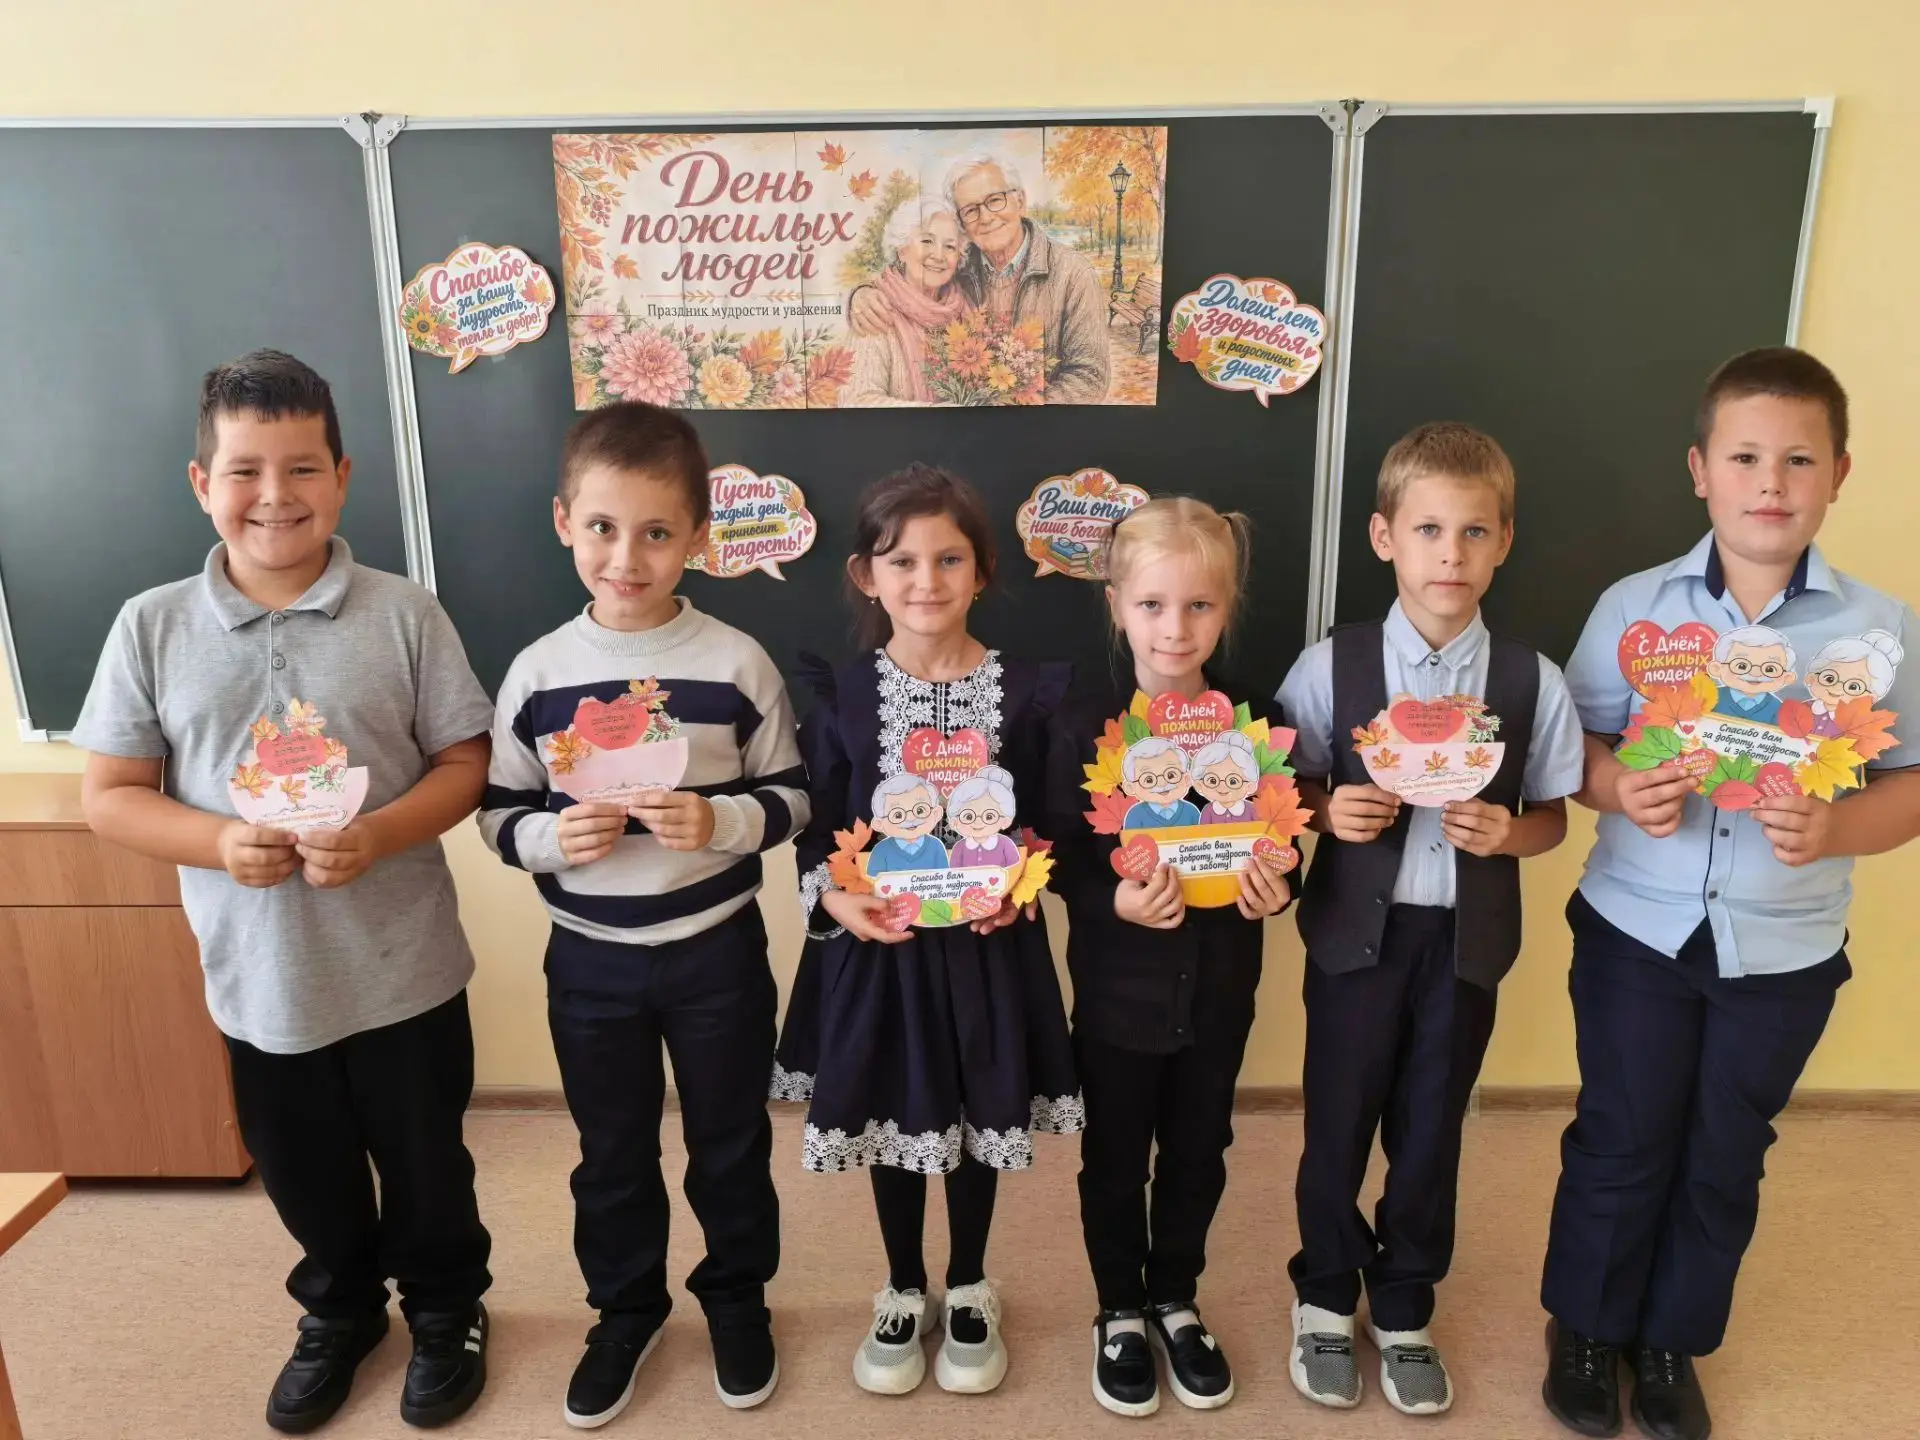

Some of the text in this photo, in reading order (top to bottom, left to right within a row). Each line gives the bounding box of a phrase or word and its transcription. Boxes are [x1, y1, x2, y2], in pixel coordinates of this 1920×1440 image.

[660, 150, 815, 209] День
[620, 211, 857, 247] пожилых
[430, 251, 527, 305] Спасибо
[660, 244, 820, 298] людей
[456, 283, 516, 316] за вашу
[1198, 279, 1321, 338] Долгих лет,
[456, 299, 528, 332] мудрость,
[648, 303, 842, 321] Праздник мудрости и уважения
[457, 306, 542, 349] тепло и добро!
[1217, 340, 1297, 369] и радостных
[1220, 359, 1280, 385] дней!
[1038, 487, 1088, 519] Ваш
[711, 502, 788, 526] ждый день
[721, 522, 780, 543] приносит
[1029, 520, 1069, 535] наше
[722, 529, 802, 567] радость!
[1638, 635, 1701, 656] С Днём
[1631, 652, 1710, 673] пожилых
[1643, 666, 1699, 684] людей!
[1165, 702, 1217, 720] С Днём
[1159, 719, 1224, 735] пожилых
[1719, 723, 1784, 744] Спасибо вам
[921, 740, 973, 757] С Днём
[1172, 731, 1216, 747] людей!
[1702, 731, 1802, 760] за доброту, мудрость
[915, 756, 980, 772] пожилых
[926, 768, 972, 784] людей!
[1168, 850, 1252, 865] за доброту, мудрость
[1178, 840, 1232, 854] Спасибо вам
[1190, 860, 1232, 872] и заботу!
[899, 885, 908, 893] за
[945, 880, 983, 893] мудрость
[911, 871, 964, 883] Спасибо вам
